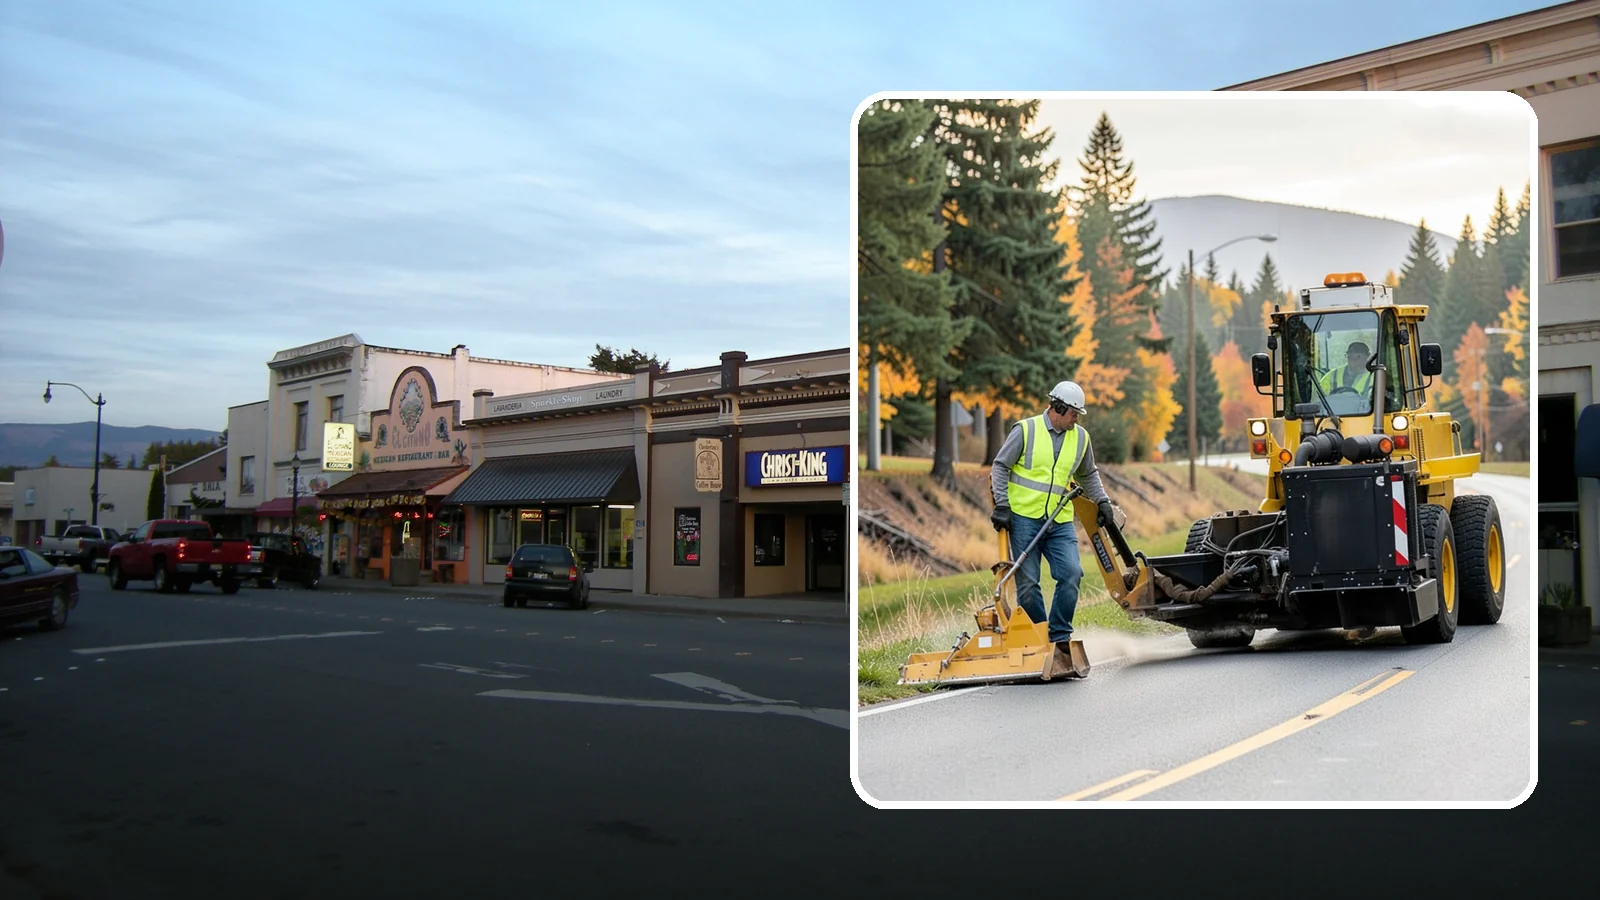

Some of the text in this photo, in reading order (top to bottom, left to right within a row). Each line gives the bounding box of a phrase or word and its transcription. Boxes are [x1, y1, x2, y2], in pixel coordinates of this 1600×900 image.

[530, 394, 582, 409] Sparkle Shop
[595, 389, 624, 400] LAUNDRY
[493, 402, 523, 412] LAVANDERIA
[373, 455, 396, 464] MEXICAN
[397, 452, 433, 462] RESTAURANT
[437, 450, 450, 459] BAR
[760, 450, 828, 478] CHRIST KING
